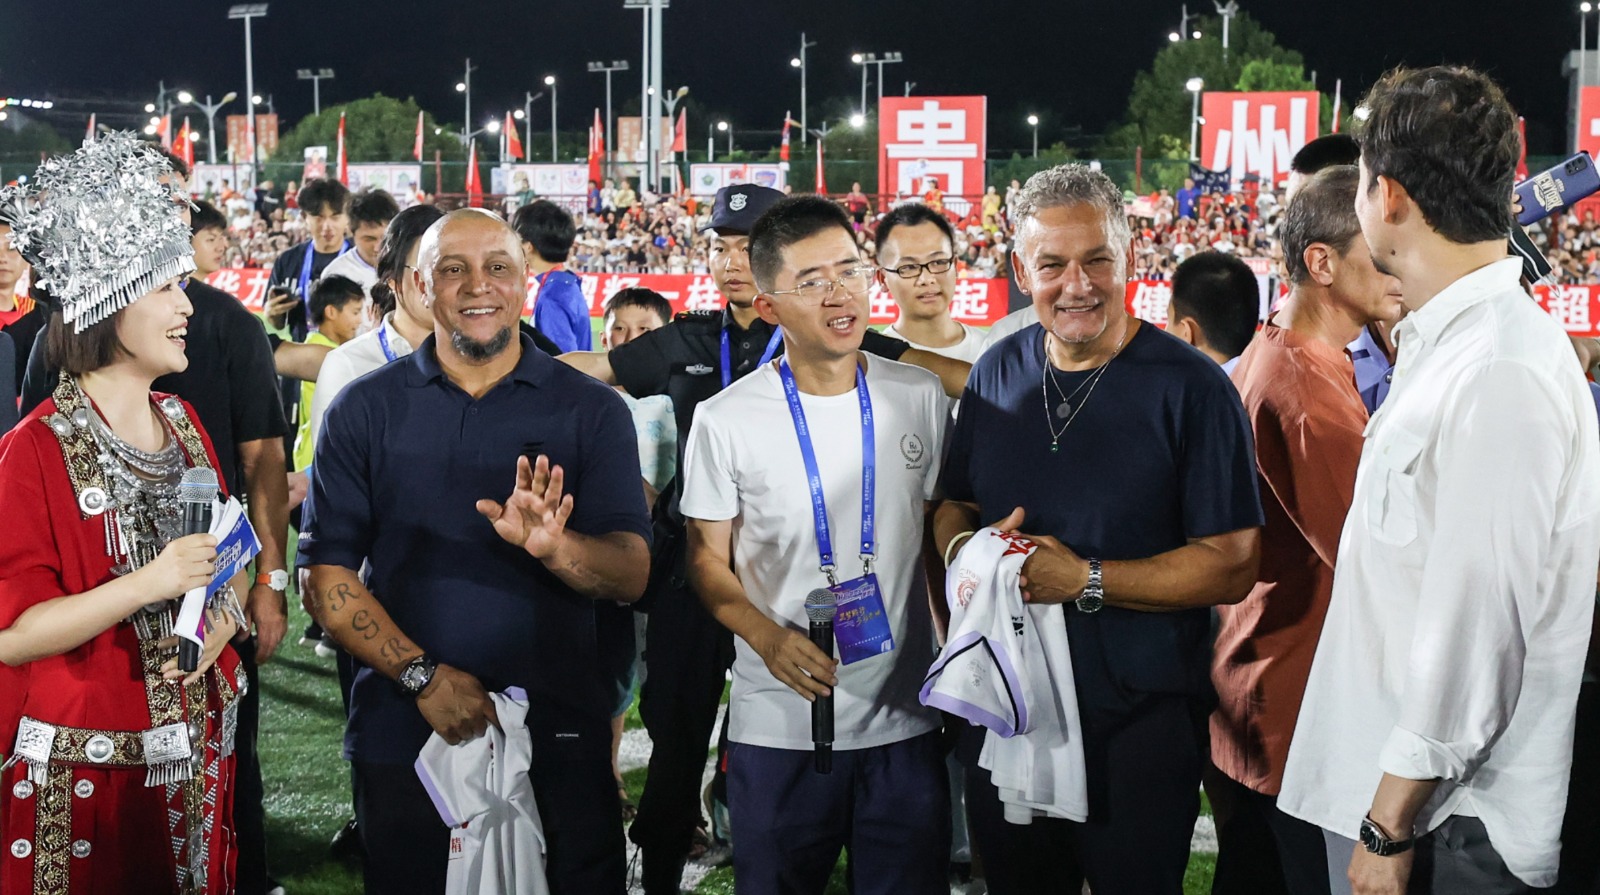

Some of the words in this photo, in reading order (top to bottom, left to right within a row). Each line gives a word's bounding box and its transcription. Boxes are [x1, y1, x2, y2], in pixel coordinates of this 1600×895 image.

[885, 100, 978, 218] 贵
[1211, 97, 1308, 192] 州
[327, 583, 361, 612] R
